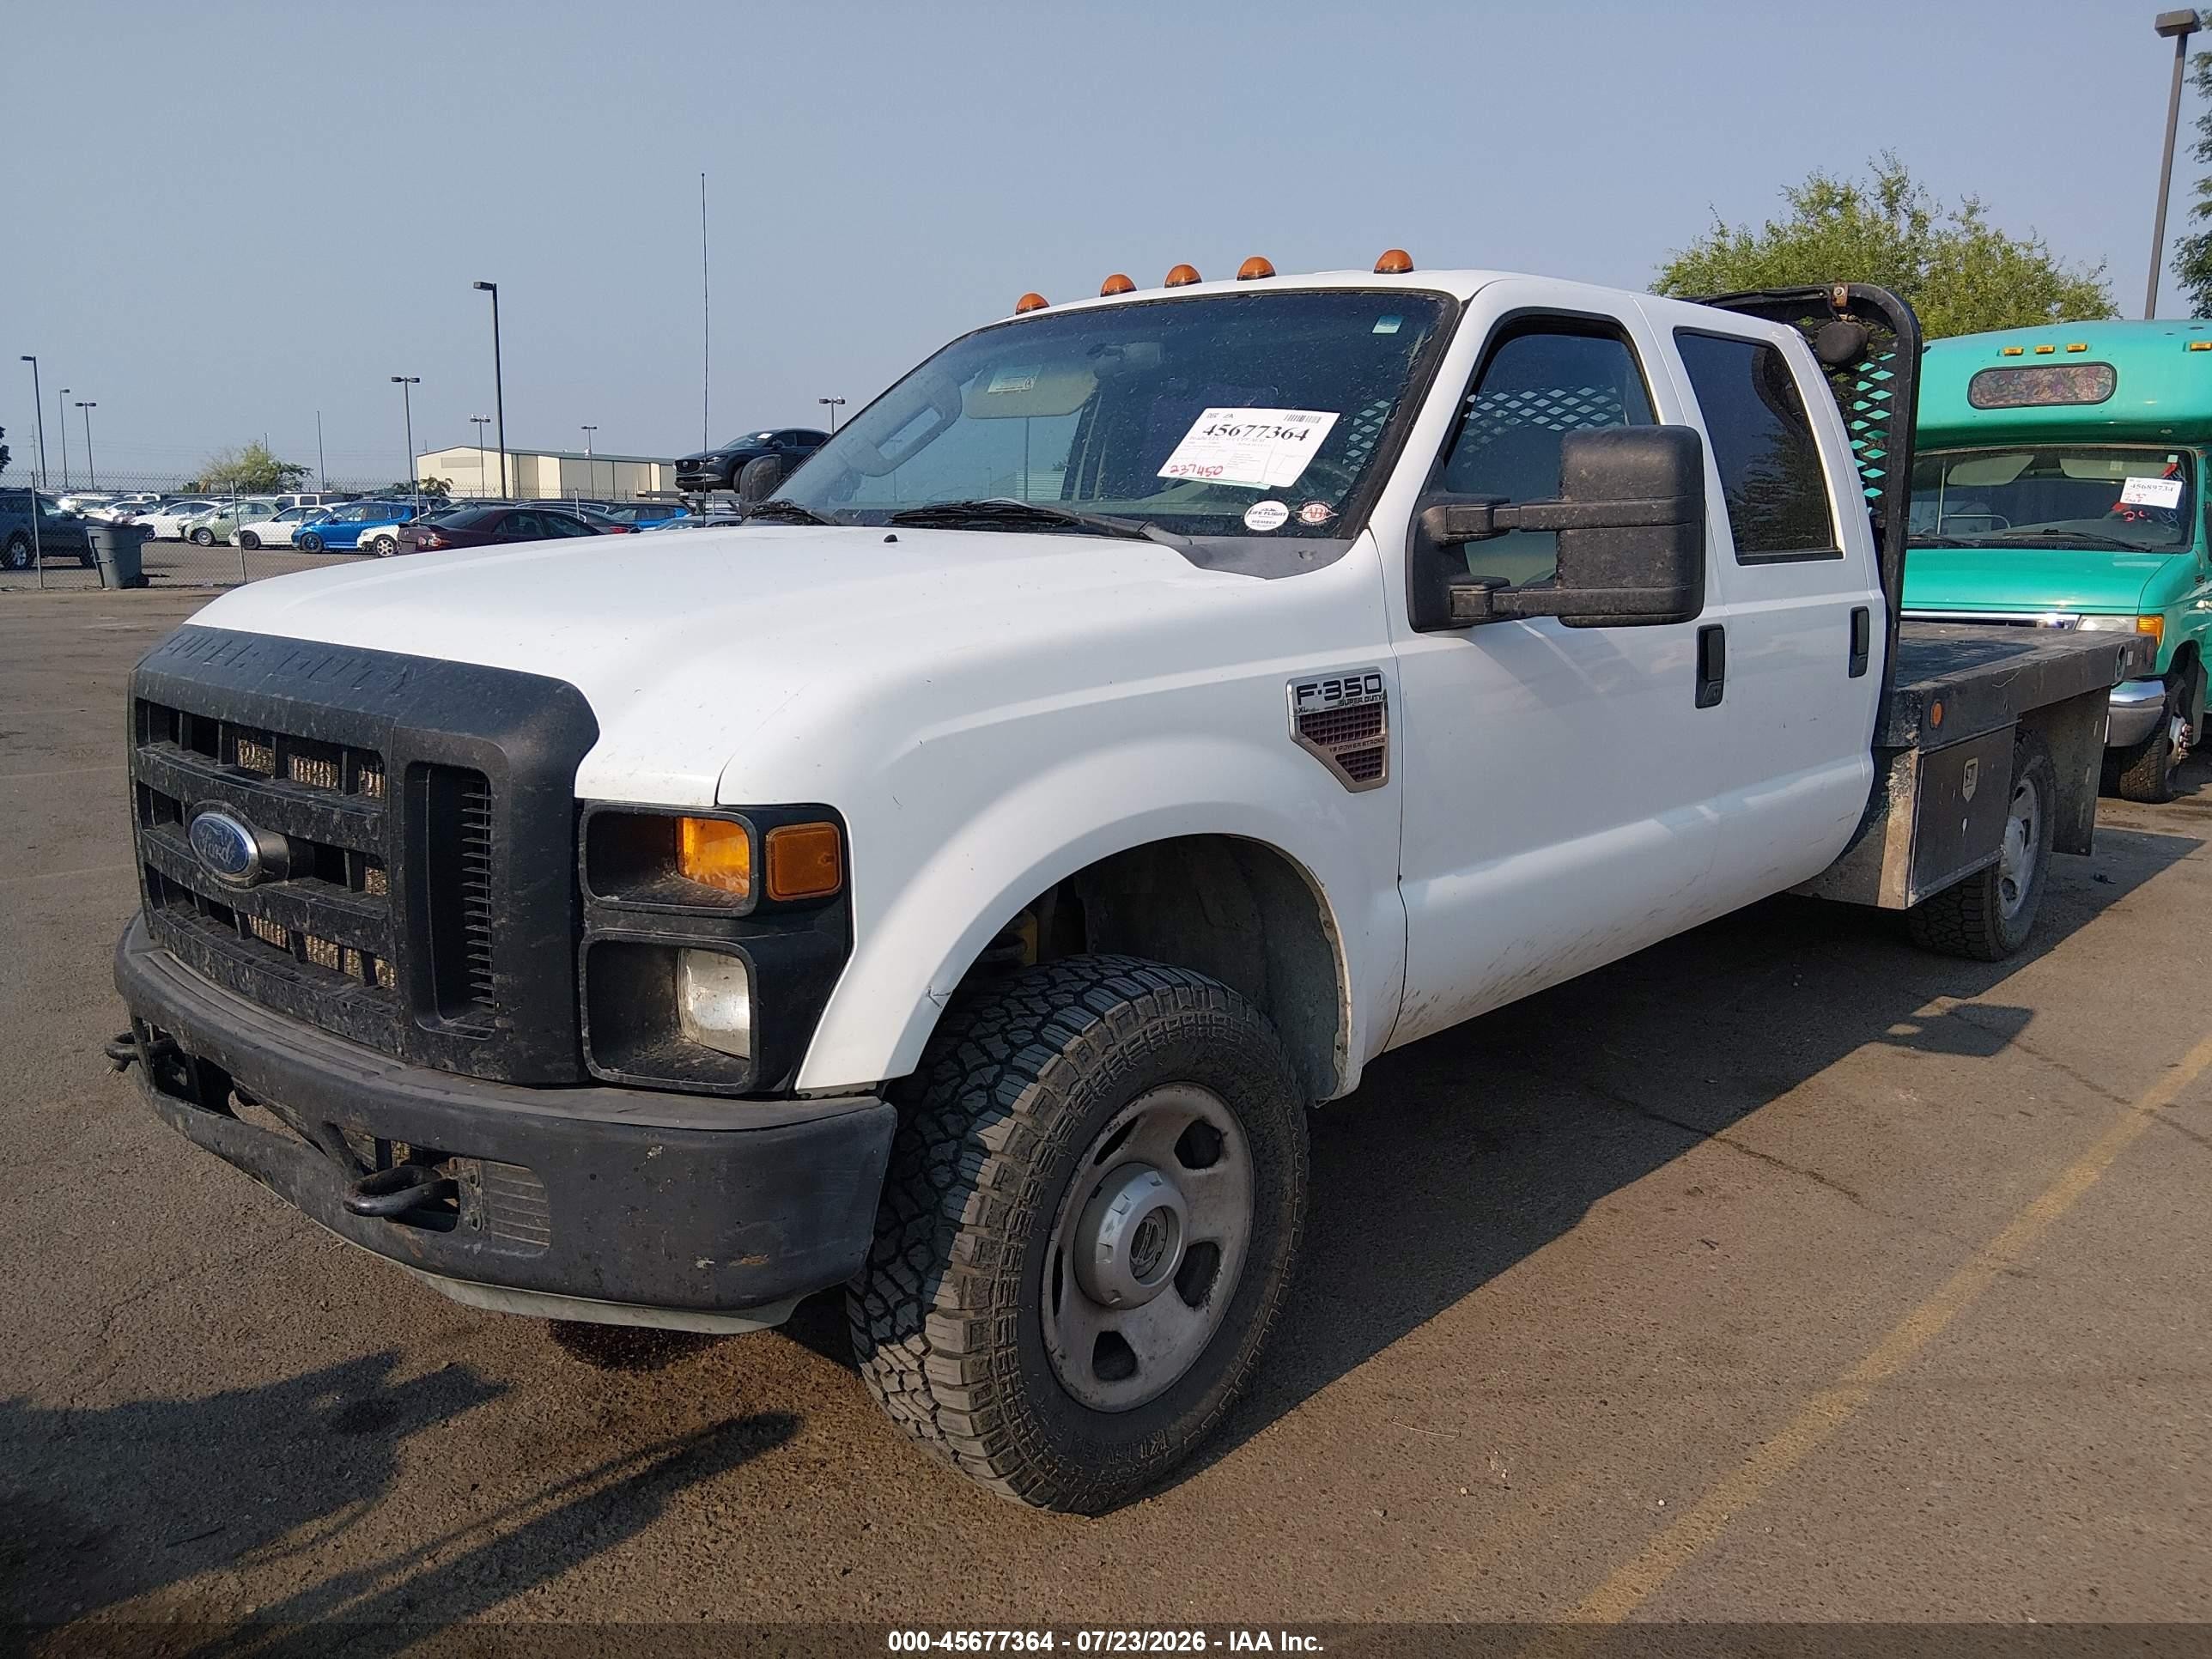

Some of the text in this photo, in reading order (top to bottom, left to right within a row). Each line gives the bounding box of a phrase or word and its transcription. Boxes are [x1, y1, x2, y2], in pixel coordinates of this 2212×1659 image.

[1203, 424, 1310, 441] 45677364
[1170, 464, 1224, 477] 237450
[1364, 693, 1383, 703] DUTY
[198, 823, 235, 866] Ford
